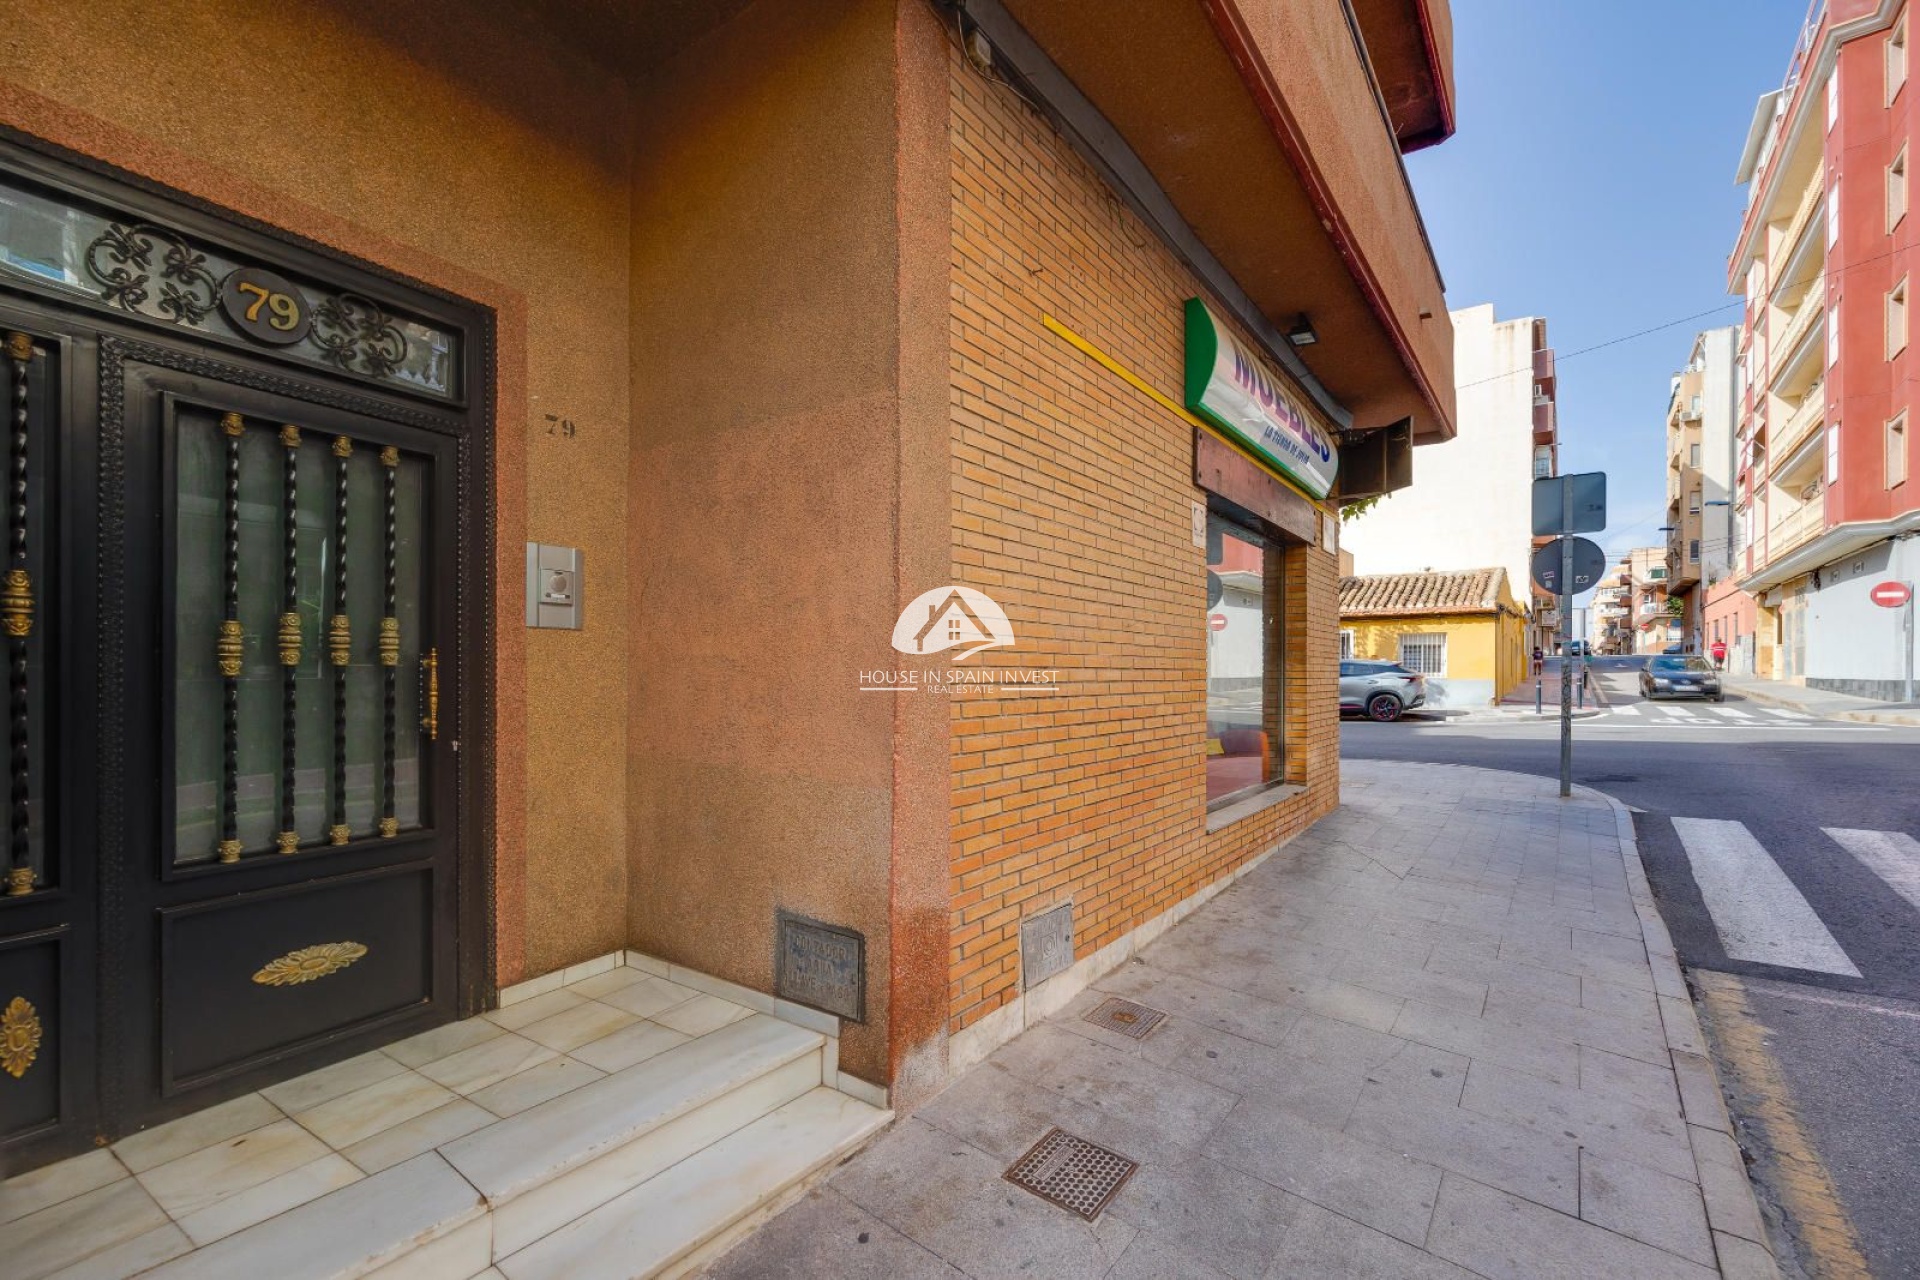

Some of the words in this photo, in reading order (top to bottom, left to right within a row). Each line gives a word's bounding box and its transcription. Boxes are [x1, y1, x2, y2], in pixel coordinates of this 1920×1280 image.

[238, 281, 300, 331] 79
[1231, 337, 1331, 463] MUEBLES
[545, 413, 576, 439] 79
